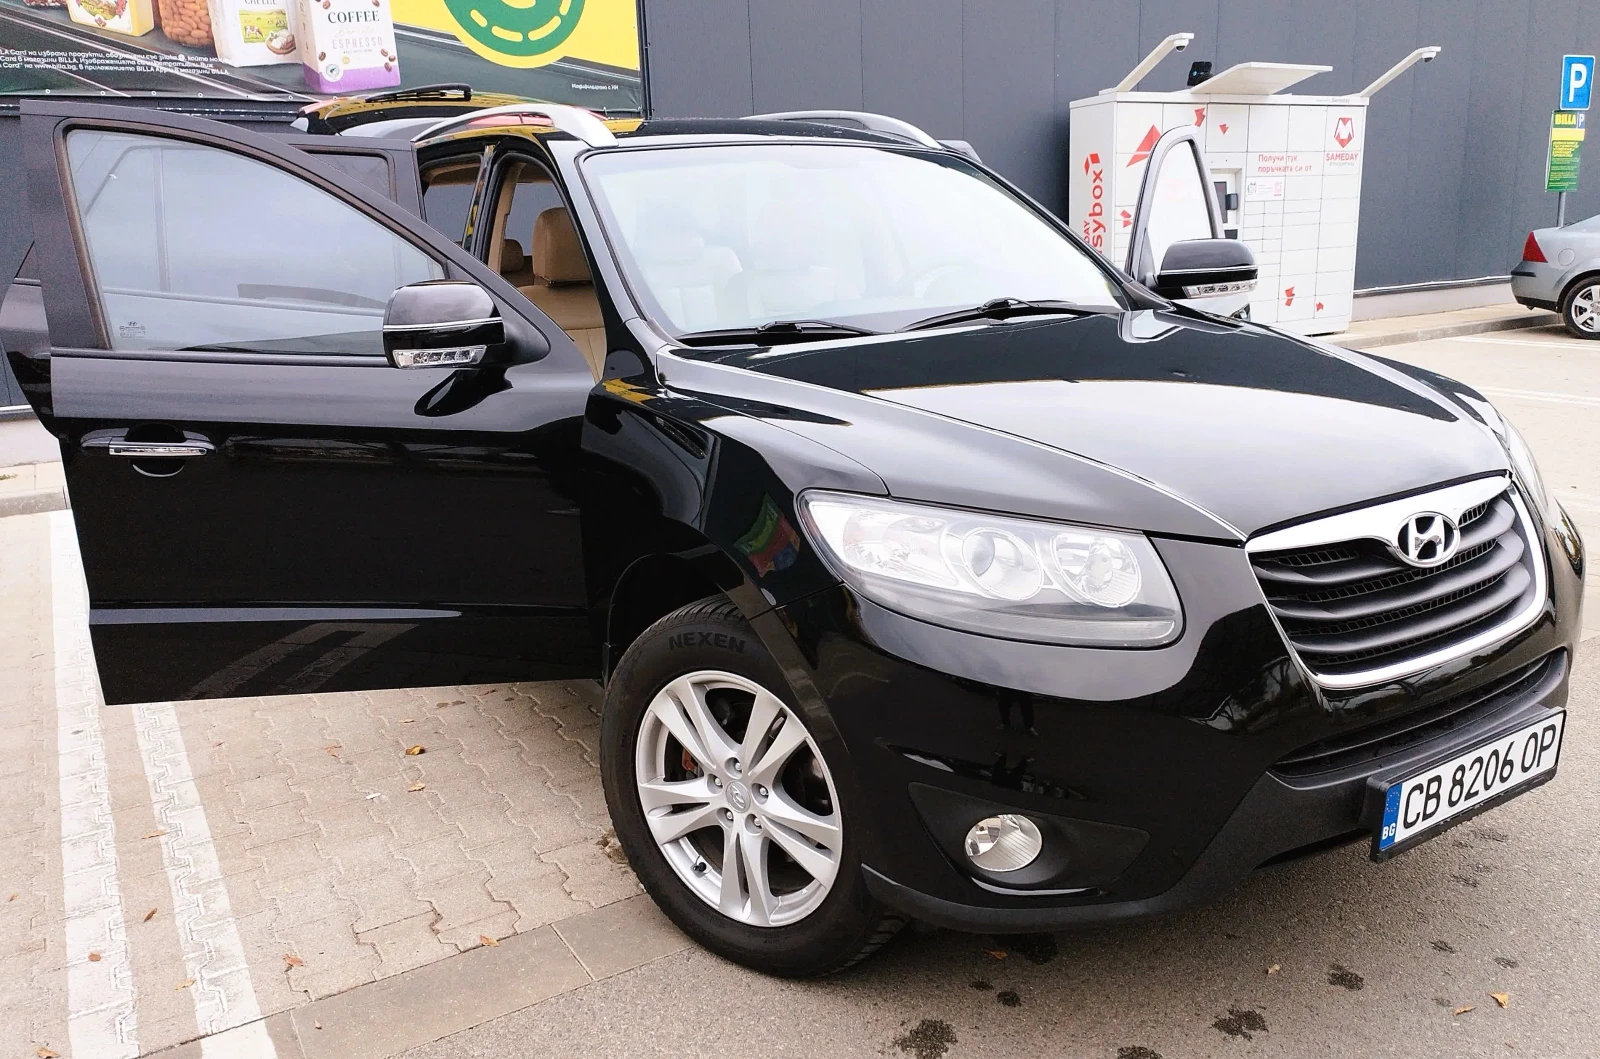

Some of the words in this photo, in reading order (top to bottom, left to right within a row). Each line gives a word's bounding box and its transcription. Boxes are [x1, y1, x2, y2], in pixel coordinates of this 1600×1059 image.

[328, 10, 380, 24] COFFEE
[332, 36, 383, 50] ESPRESSO
[1569, 63, 1587, 102] P
[1555, 114, 1576, 125] BILLA
[1578, 113, 1585, 128] P
[1258, 154, 1285, 163] Получи
[1287, 155, 1298, 163] тук
[1326, 153, 1359, 161] SAMEDAY
[1258, 165, 1293, 174] поръчката
[1088, 168, 1106, 254] sybox
[669, 631, 747, 653] NEXEN
[1403, 774, 1442, 830] CB
[1447, 740, 1515, 808] 8206
[1520, 723, 1557, 774] OP
[1382, 822, 1396, 840] BG
